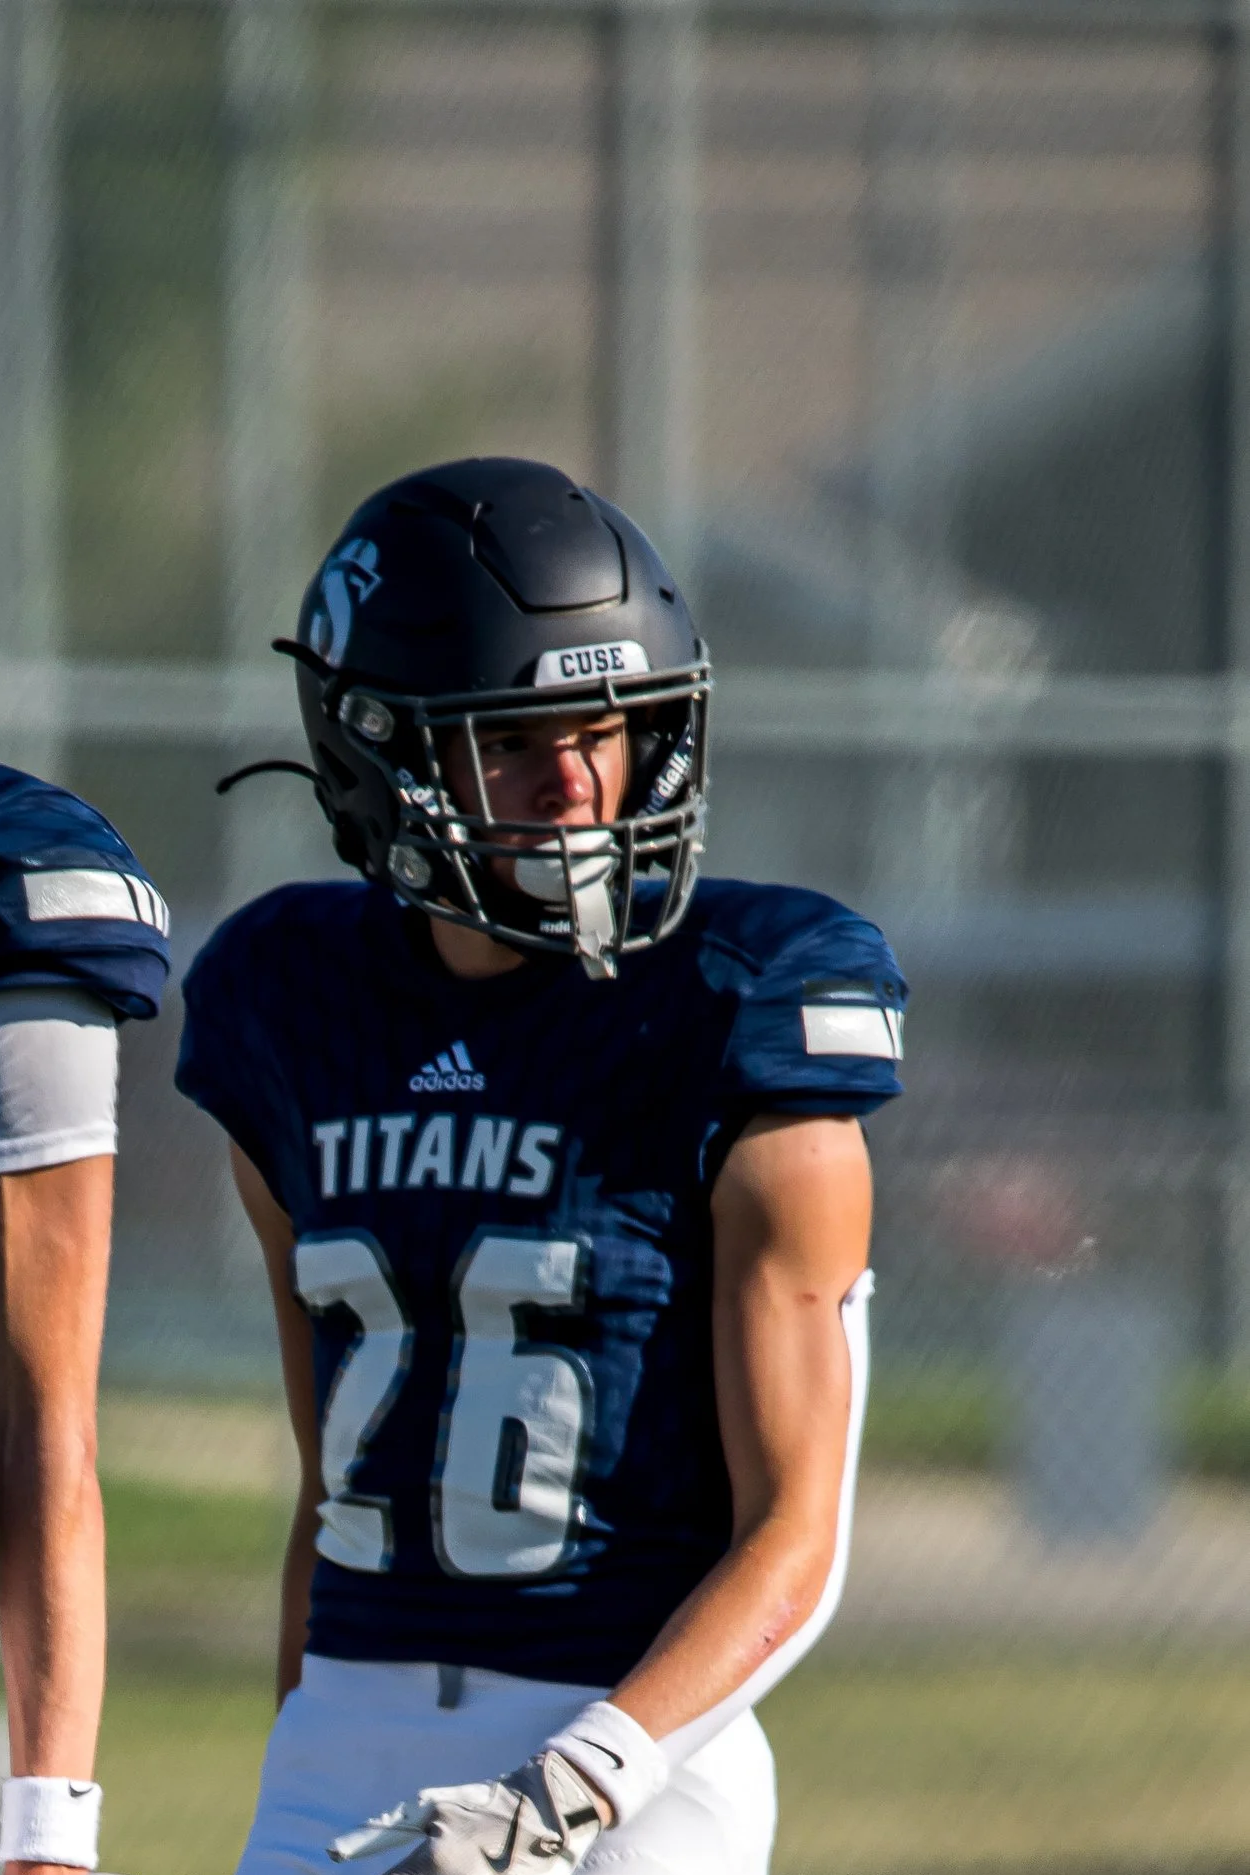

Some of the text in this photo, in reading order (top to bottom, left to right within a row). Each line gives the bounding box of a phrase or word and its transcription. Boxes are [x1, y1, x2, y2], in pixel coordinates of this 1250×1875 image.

[559, 647, 626, 678] CUSE
[408, 1071, 486, 1093] adidas
[313, 1114, 559, 1198] TITANS
[293, 1226, 593, 1577] 26
